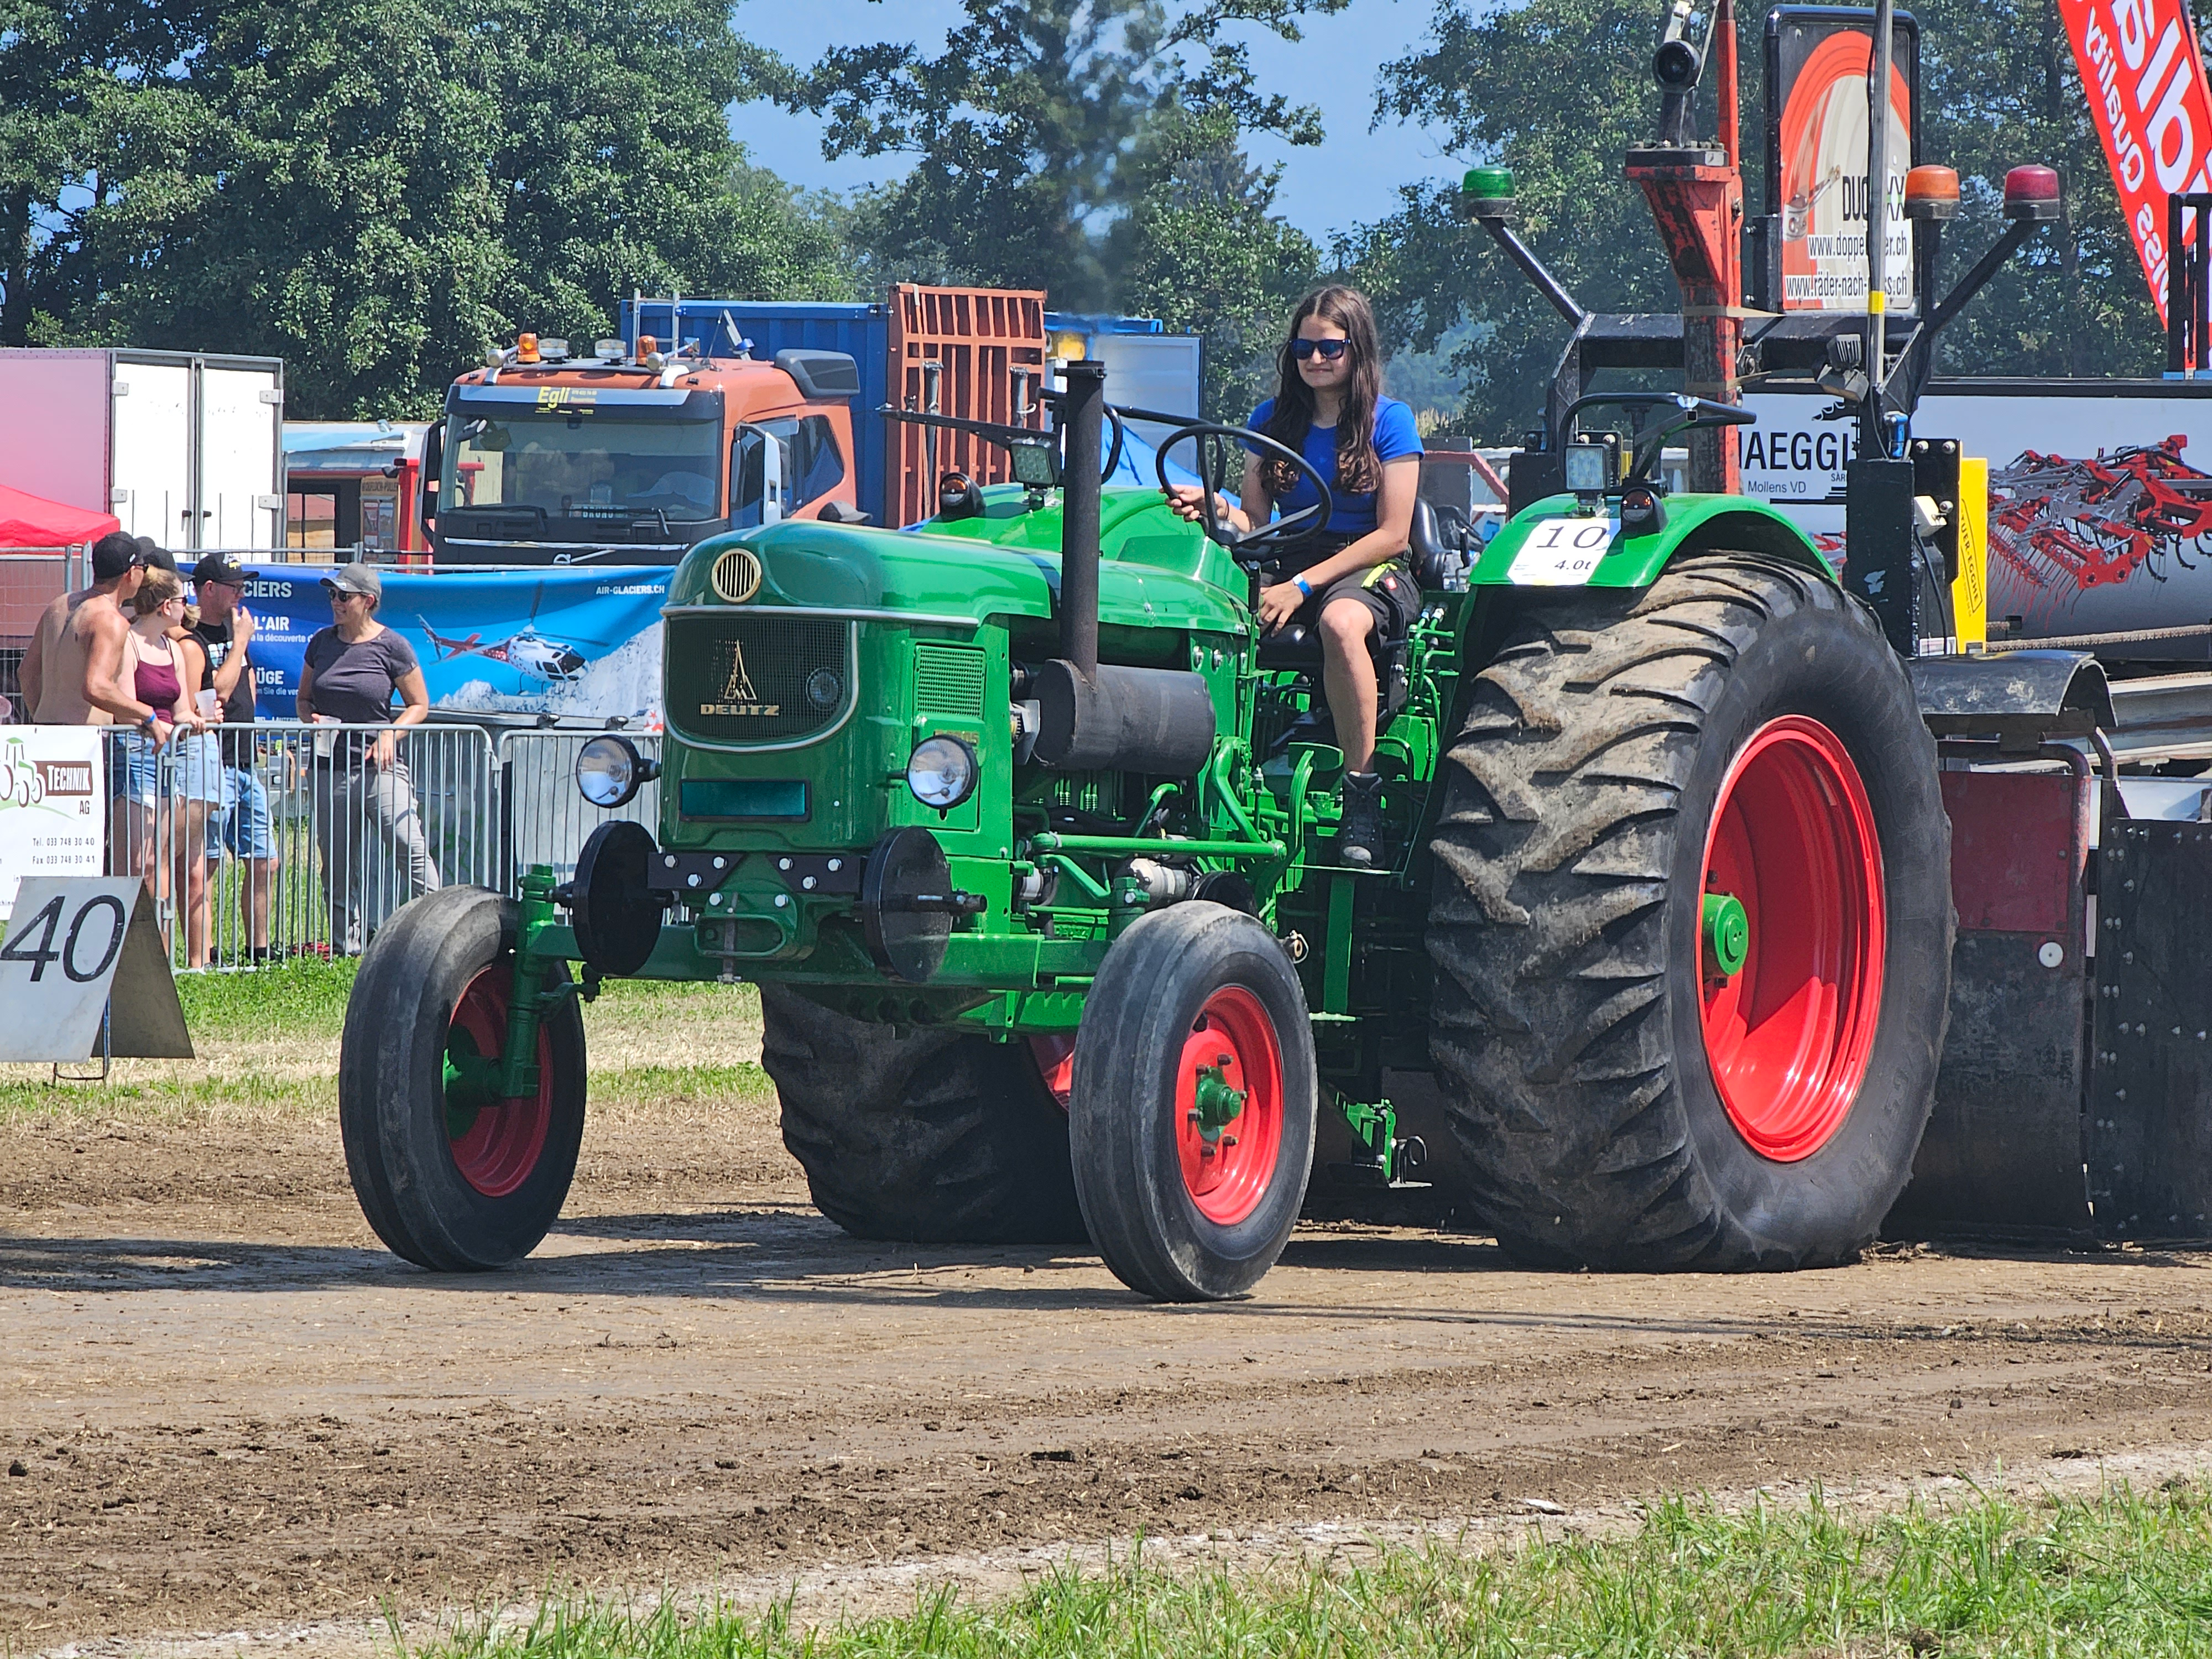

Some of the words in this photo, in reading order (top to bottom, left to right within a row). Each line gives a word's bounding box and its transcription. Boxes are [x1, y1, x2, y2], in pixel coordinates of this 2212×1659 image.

[537, 386, 571, 409] Egli
[1747, 480, 1787, 493] Mollens
[1790, 481, 1807, 493] VD
[1536, 526, 1608, 548] 10
[1554, 560, 1592, 570] 4.0t
[596, 585, 665, 595] AIR-GLACIERS.CH
[265, 633, 306, 643] découverte
[700, 704, 780, 716] DEUTZ
[46, 765, 91, 791] TECHNIK
[79, 800, 90, 815] AG
[33, 837, 44, 847] Tel.
[46, 837, 57, 846] 033
[60, 837, 71, 846] 748
[74, 837, 82, 846] 30
[85, 837, 95, 846] 40
[33, 855, 44, 865] Fax
[46, 855, 58, 864] 033
[61, 855, 71, 864] 748
[75, 855, 82, 864] 30
[86, 855, 95, 864] 41
[0, 895, 125, 983] 40
